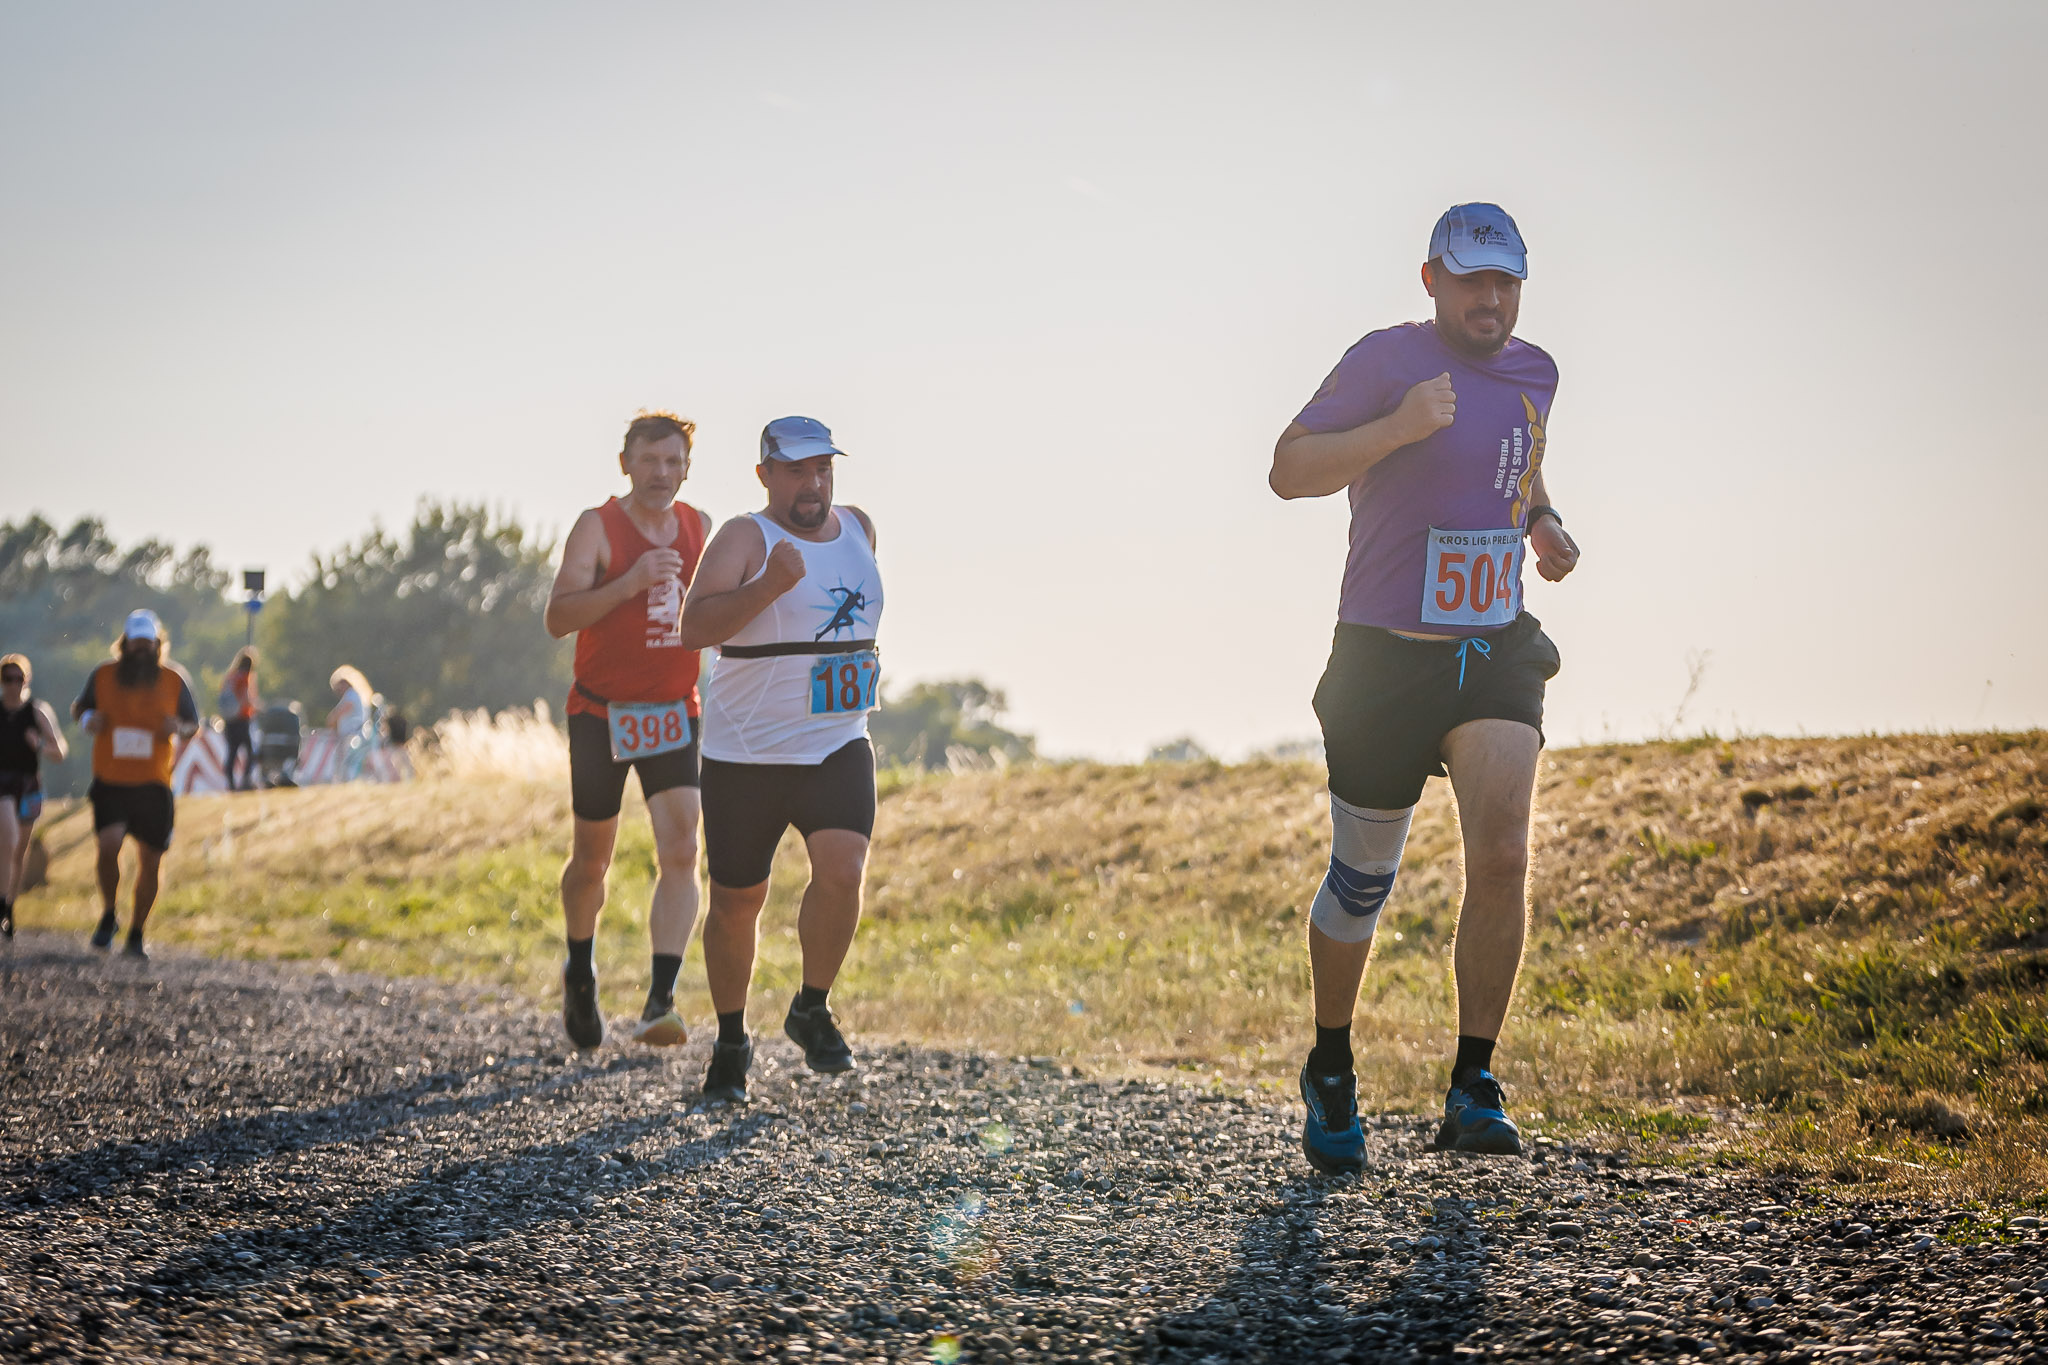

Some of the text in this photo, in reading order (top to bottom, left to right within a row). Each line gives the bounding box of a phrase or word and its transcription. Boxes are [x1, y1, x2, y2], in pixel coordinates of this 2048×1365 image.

[1494, 438, 1509, 489] PRELOG 2020
[1503, 427, 1523, 499] KROS LIGA
[1438, 534, 1518, 546] KROS LIGA PRELOG
[1435, 552, 1513, 613] 504
[816, 661, 876, 712] 187
[618, 710, 683, 752] 398
